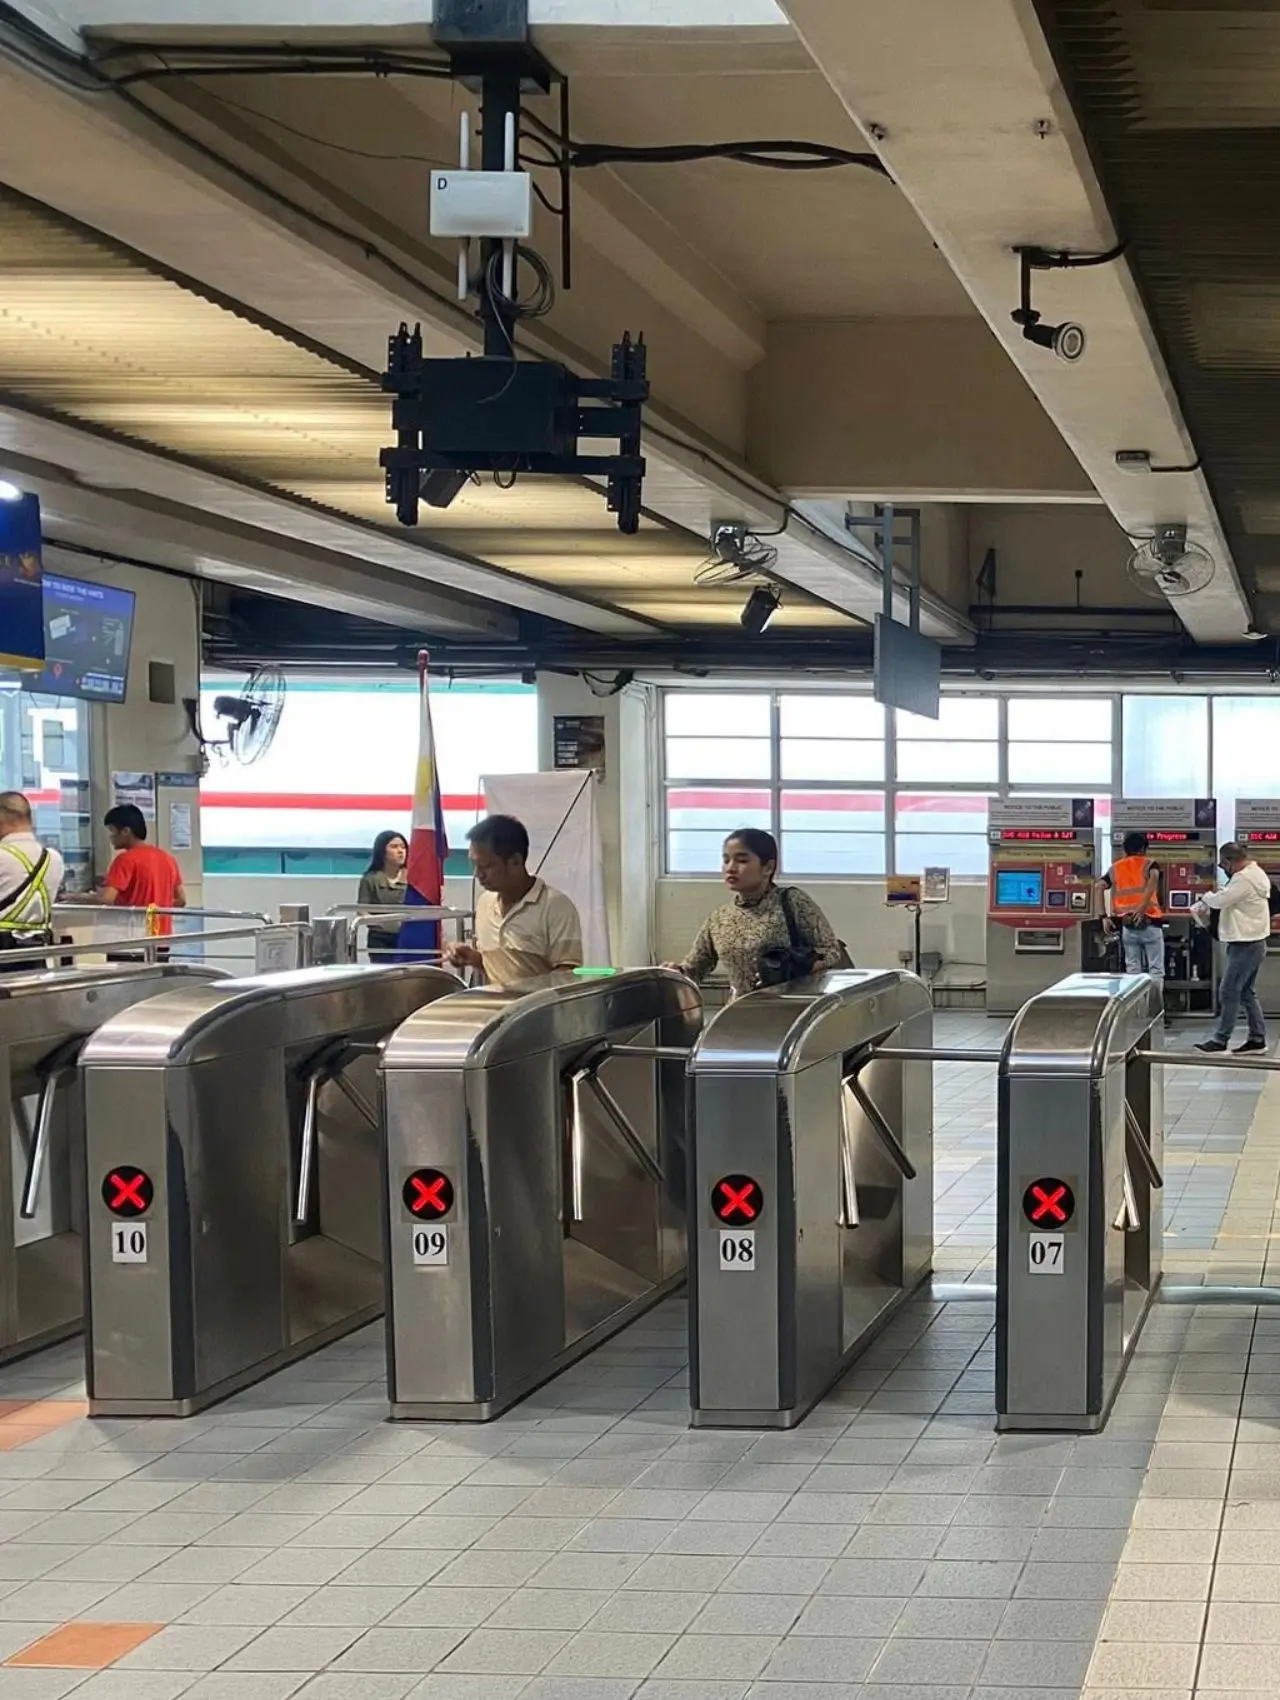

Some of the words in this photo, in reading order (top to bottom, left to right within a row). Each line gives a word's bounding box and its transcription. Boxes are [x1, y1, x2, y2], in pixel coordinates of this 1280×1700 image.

[438, 178, 447, 190] D
[1156, 832, 1187, 841] Progress
[116, 1230, 145, 1254] 10
[414, 1232, 446, 1256] 09
[721, 1238, 754, 1262] 08
[1030, 1241, 1062, 1265] 07
